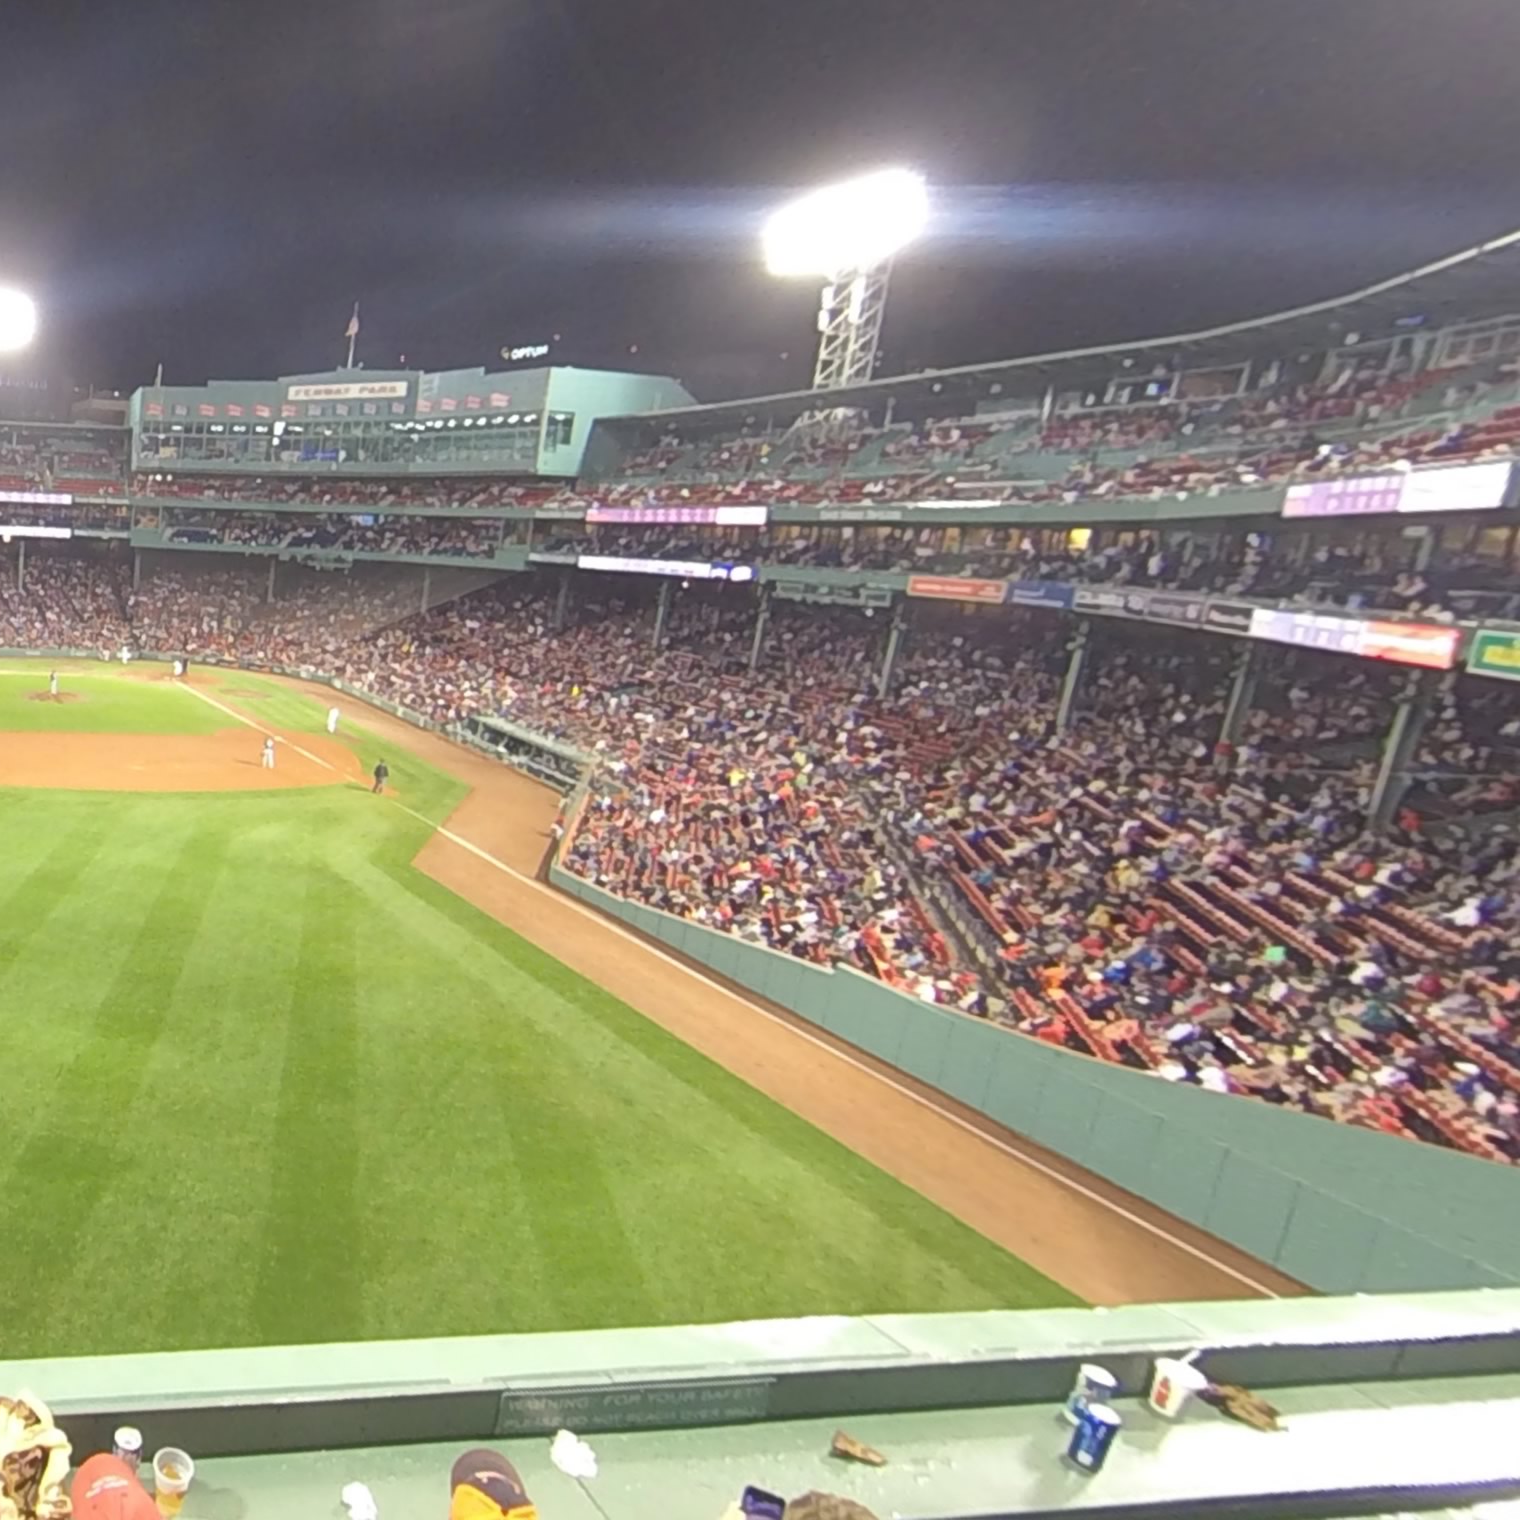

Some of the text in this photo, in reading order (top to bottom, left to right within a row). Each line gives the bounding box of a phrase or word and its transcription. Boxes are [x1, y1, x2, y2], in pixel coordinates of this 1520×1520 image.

[294, 385, 398, 398] FENWAY PARK
[508, 1387, 766, 1411] WARNING FOR YOUR SAFETY
